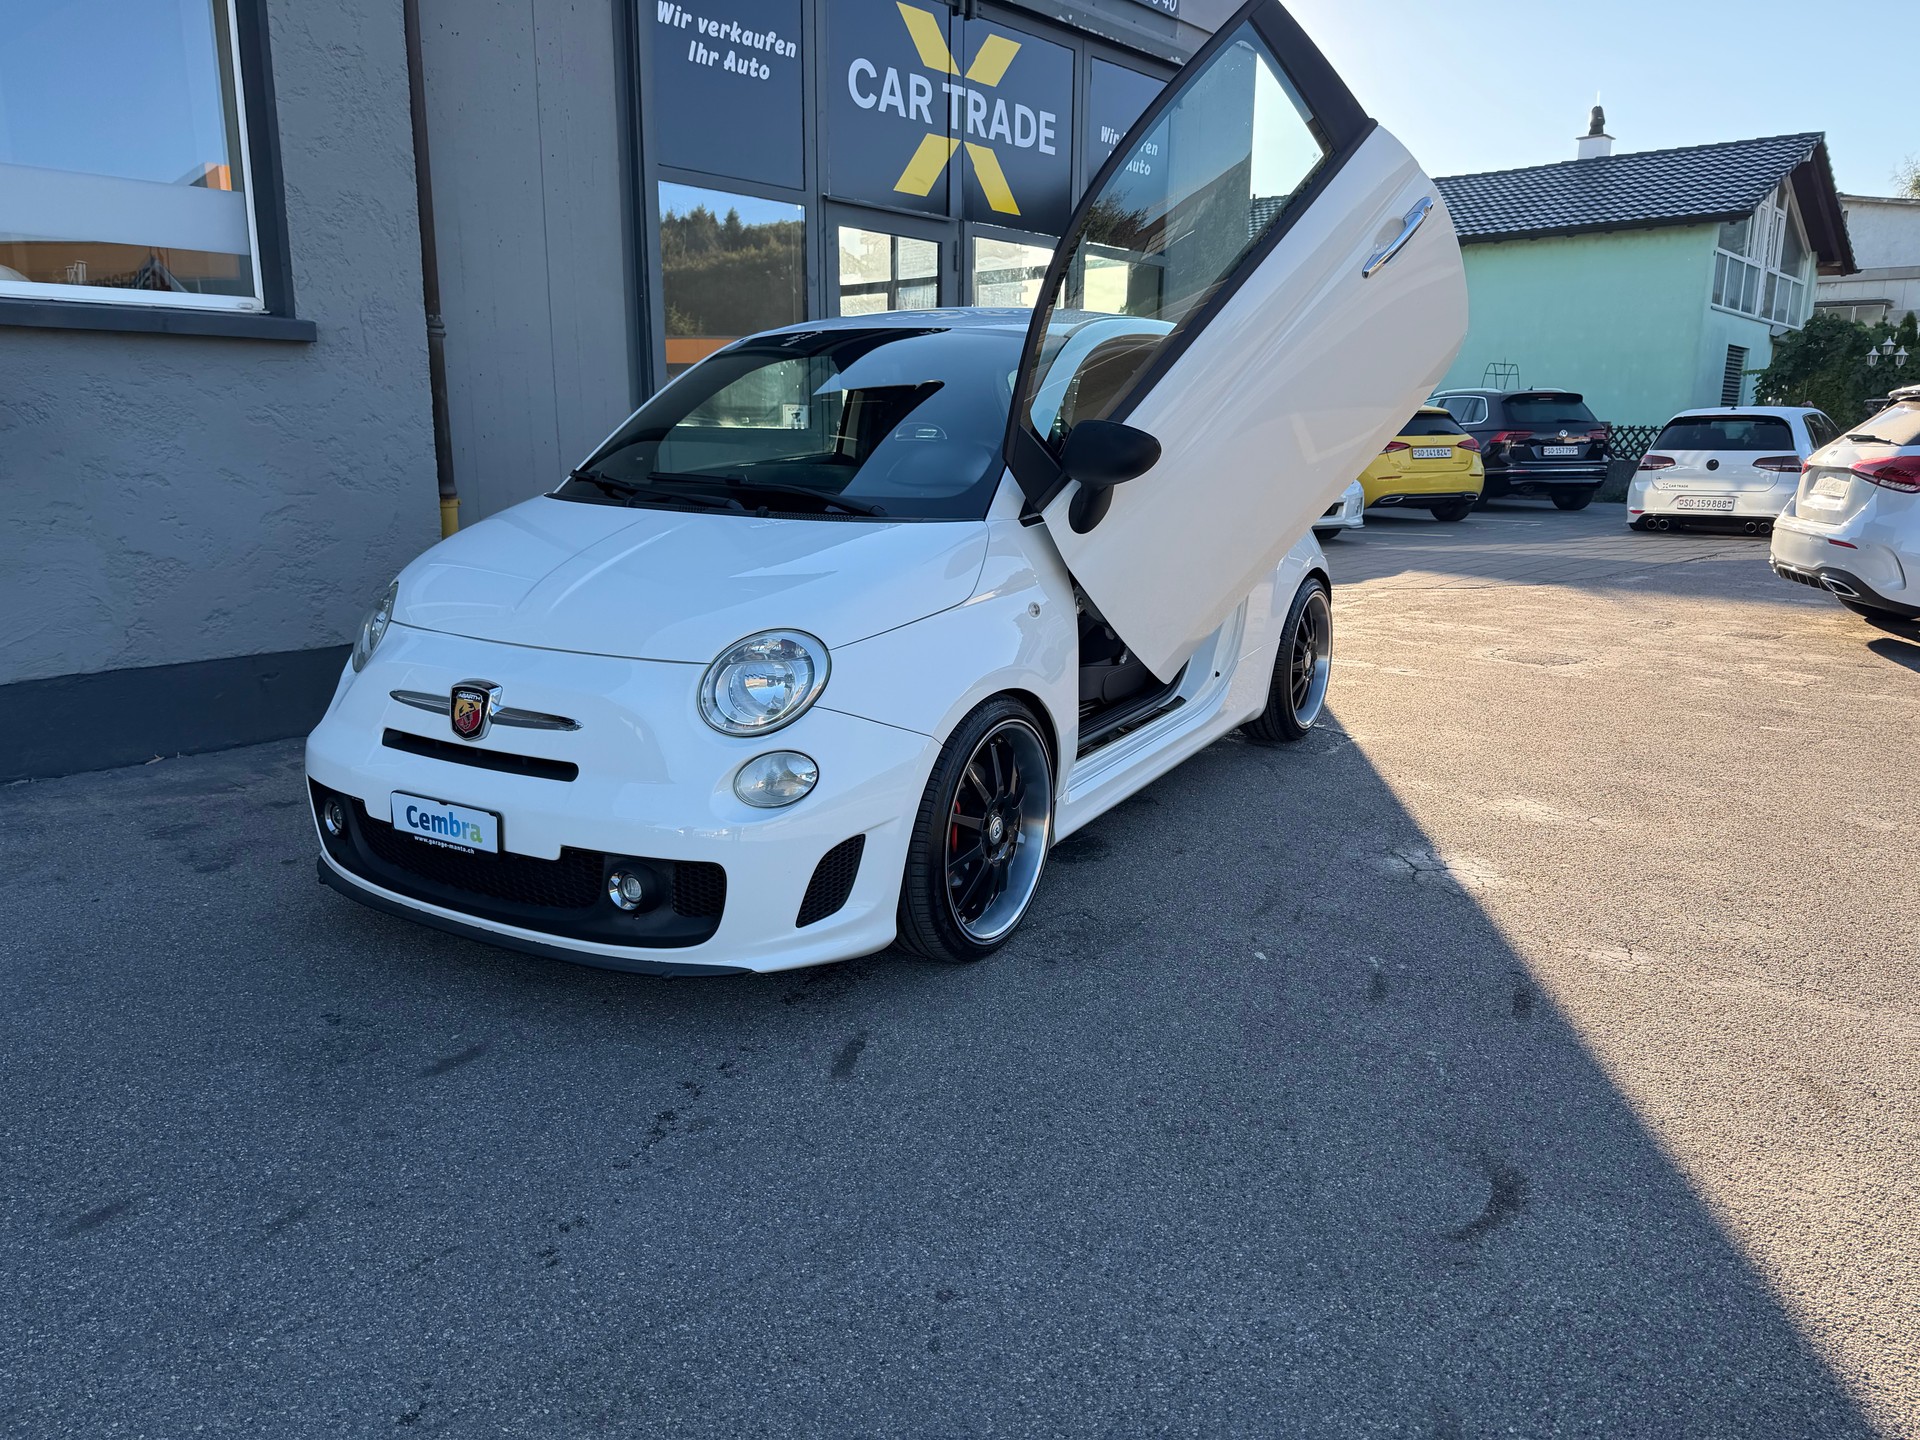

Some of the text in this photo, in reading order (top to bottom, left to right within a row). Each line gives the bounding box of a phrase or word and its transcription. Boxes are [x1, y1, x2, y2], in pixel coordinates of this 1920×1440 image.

[657, 0, 797, 58] Wir verkaufen
[688, 40, 770, 80] Ihr Auto
[848, 58, 1056, 156] CAR TRADE
[1100, 125, 1120, 145] Wir
[406, 805, 483, 844] Cembra
